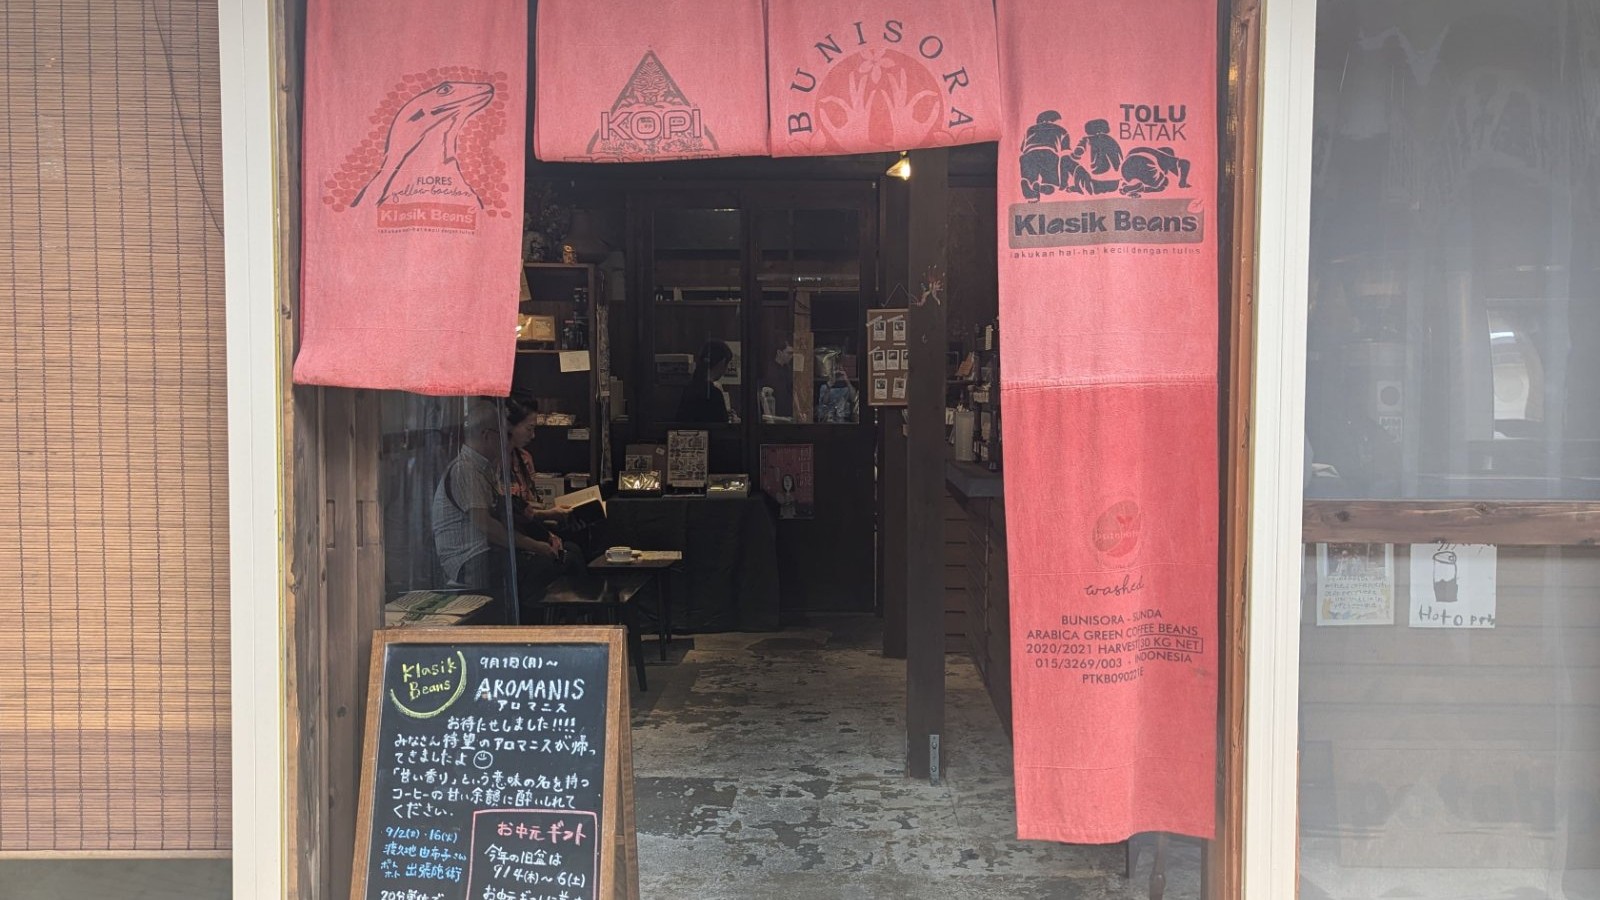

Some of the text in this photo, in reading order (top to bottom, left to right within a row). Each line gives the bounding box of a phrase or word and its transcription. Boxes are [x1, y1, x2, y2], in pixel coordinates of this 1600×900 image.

[788, 20, 974, 136] BUNISORA
[1119, 104, 1187, 123] TOLU
[600, 109, 701, 140] KOPI
[1119, 122, 1187, 141] BATAK
[416, 176, 453, 186] FLORES
[381, 208, 474, 223] Klasik Beans
[1014, 210, 1198, 236] Klasik Beans
[1084, 574, 1145, 596] washed
[1061, 615, 1124, 626] BUNISORA
[1132, 609, 1162, 623] SUNDA
[1027, 624, 1198, 640] ARABICA GREEN COFFEE BEANS
[1026, 637, 1199, 654] 2020/2021 HARVEST 30 KG NET
[1035, 658, 1122, 669] 015/3269/003
[1135, 650, 1193, 663] INDONESIA
[402, 657, 457, 682] Klasik
[409, 680, 451, 701] Beans
[474, 678, 585, 701] AROMANIS
[498, 700, 568, 713] アロマニス
[395, 748, 468, 766] てきましたよ
[484, 844, 562, 866] 今年の旧盆は
